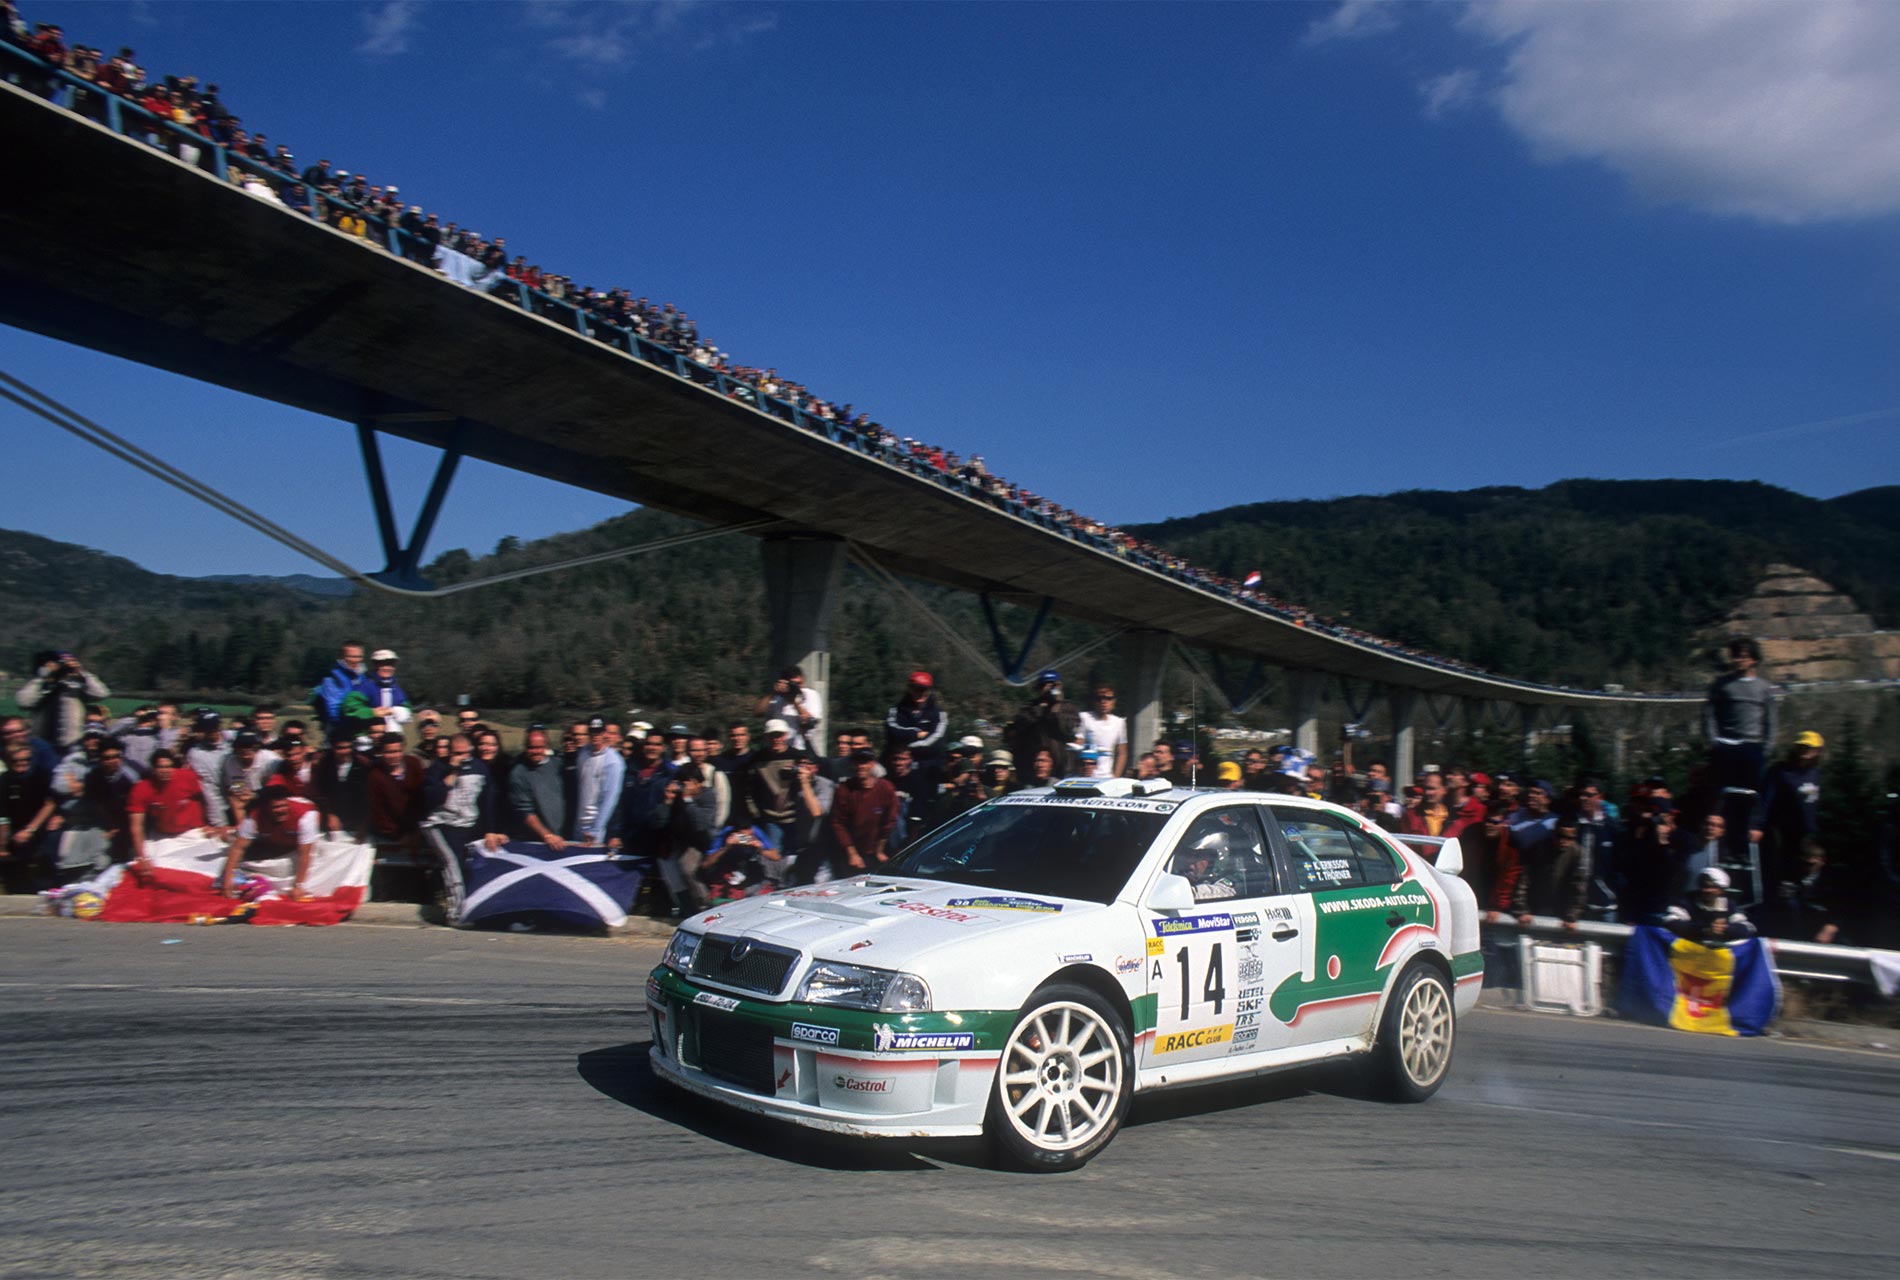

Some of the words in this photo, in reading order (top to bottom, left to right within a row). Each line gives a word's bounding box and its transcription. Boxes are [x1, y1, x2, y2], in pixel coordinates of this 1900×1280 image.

[1320, 859, 1350, 870] ERIKSSON
[1318, 894, 1429, 914] WWW.SKODA-AUTO.COM
[899, 902, 980, 923] Castrol
[1197, 916, 1231, 929] MoviStar
[1148, 940, 1164, 949] RACC
[1151, 959, 1163, 980] A
[1176, 942, 1226, 1021] 14
[1236, 997, 1264, 1013] SKF
[1235, 1013, 1255, 1027] TRS
[793, 1023, 837, 1042] sparco
[895, 1036, 971, 1048] MICHELIN
[1165, 1031, 1204, 1052] RACC
[1206, 1034, 1222, 1045] CLUB
[845, 1077, 888, 1092] Castrol
